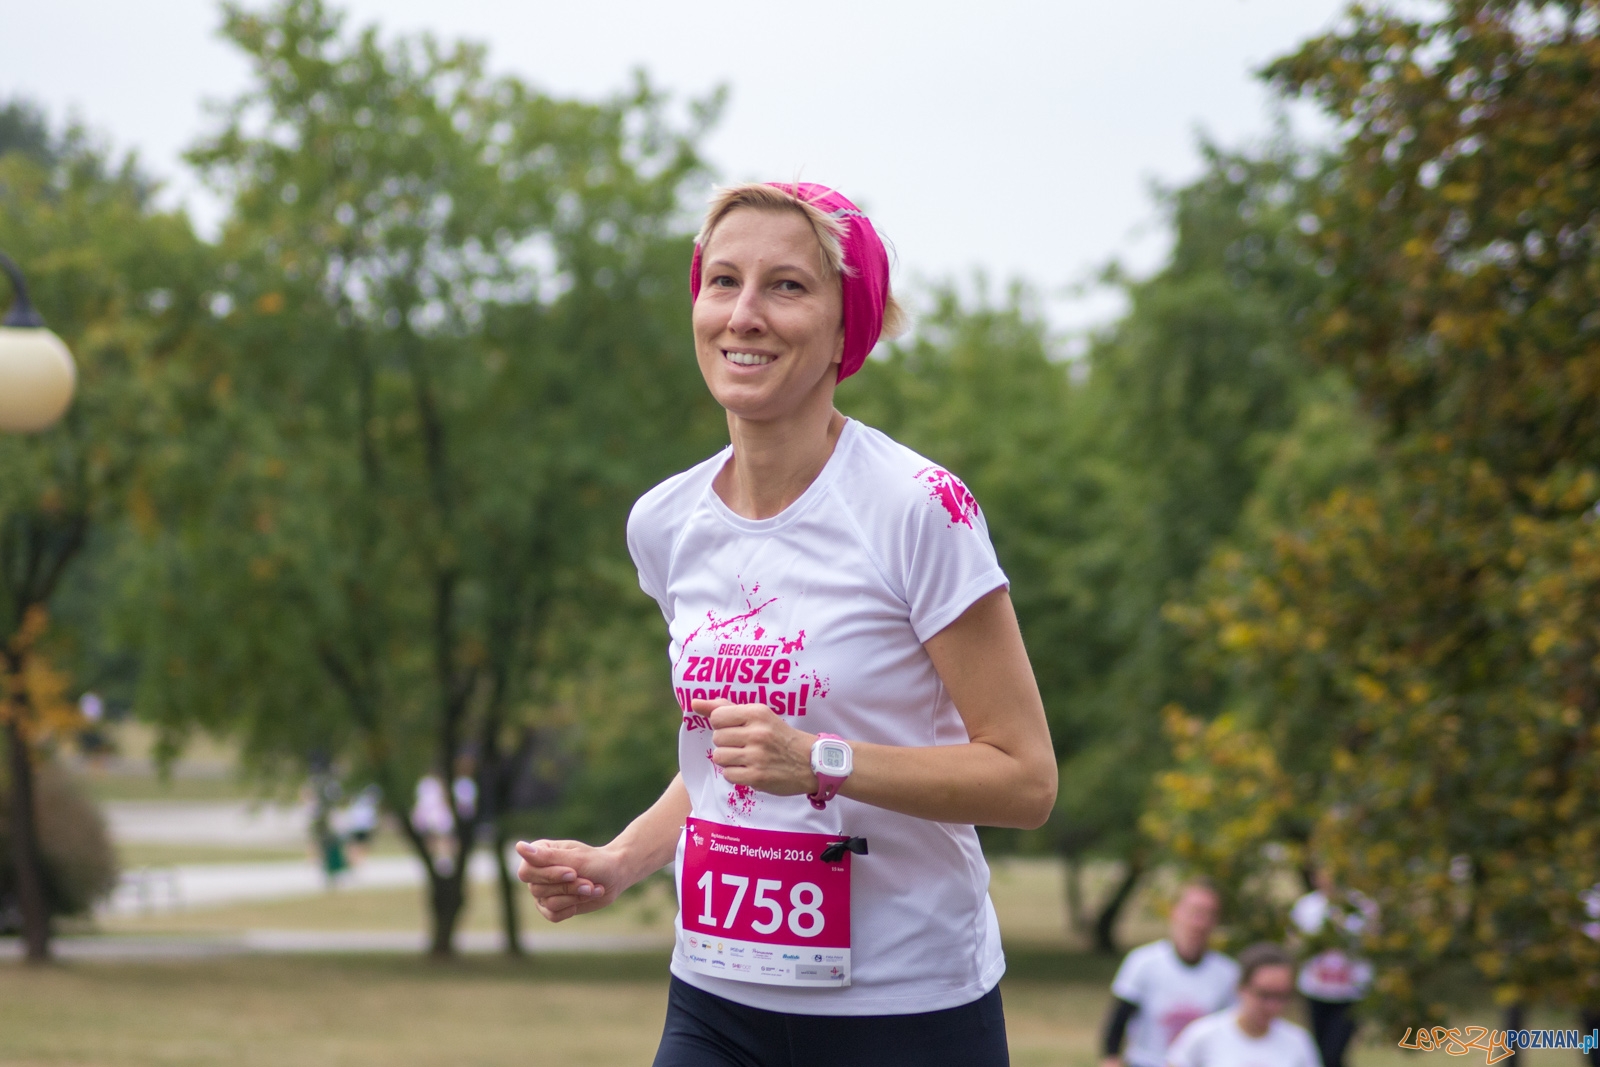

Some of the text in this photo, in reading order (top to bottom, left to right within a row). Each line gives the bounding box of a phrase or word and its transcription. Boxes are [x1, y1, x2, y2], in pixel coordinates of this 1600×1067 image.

[718, 643, 779, 657] BIEG KOBIET
[683, 656, 791, 684] zawsze
[683, 715, 713, 731] 201
[710, 840, 738, 855] Zawsze
[740, 844, 782, 860] Pier(w)si
[784, 850, 813, 861] 2016
[697, 870, 826, 938] 1758
